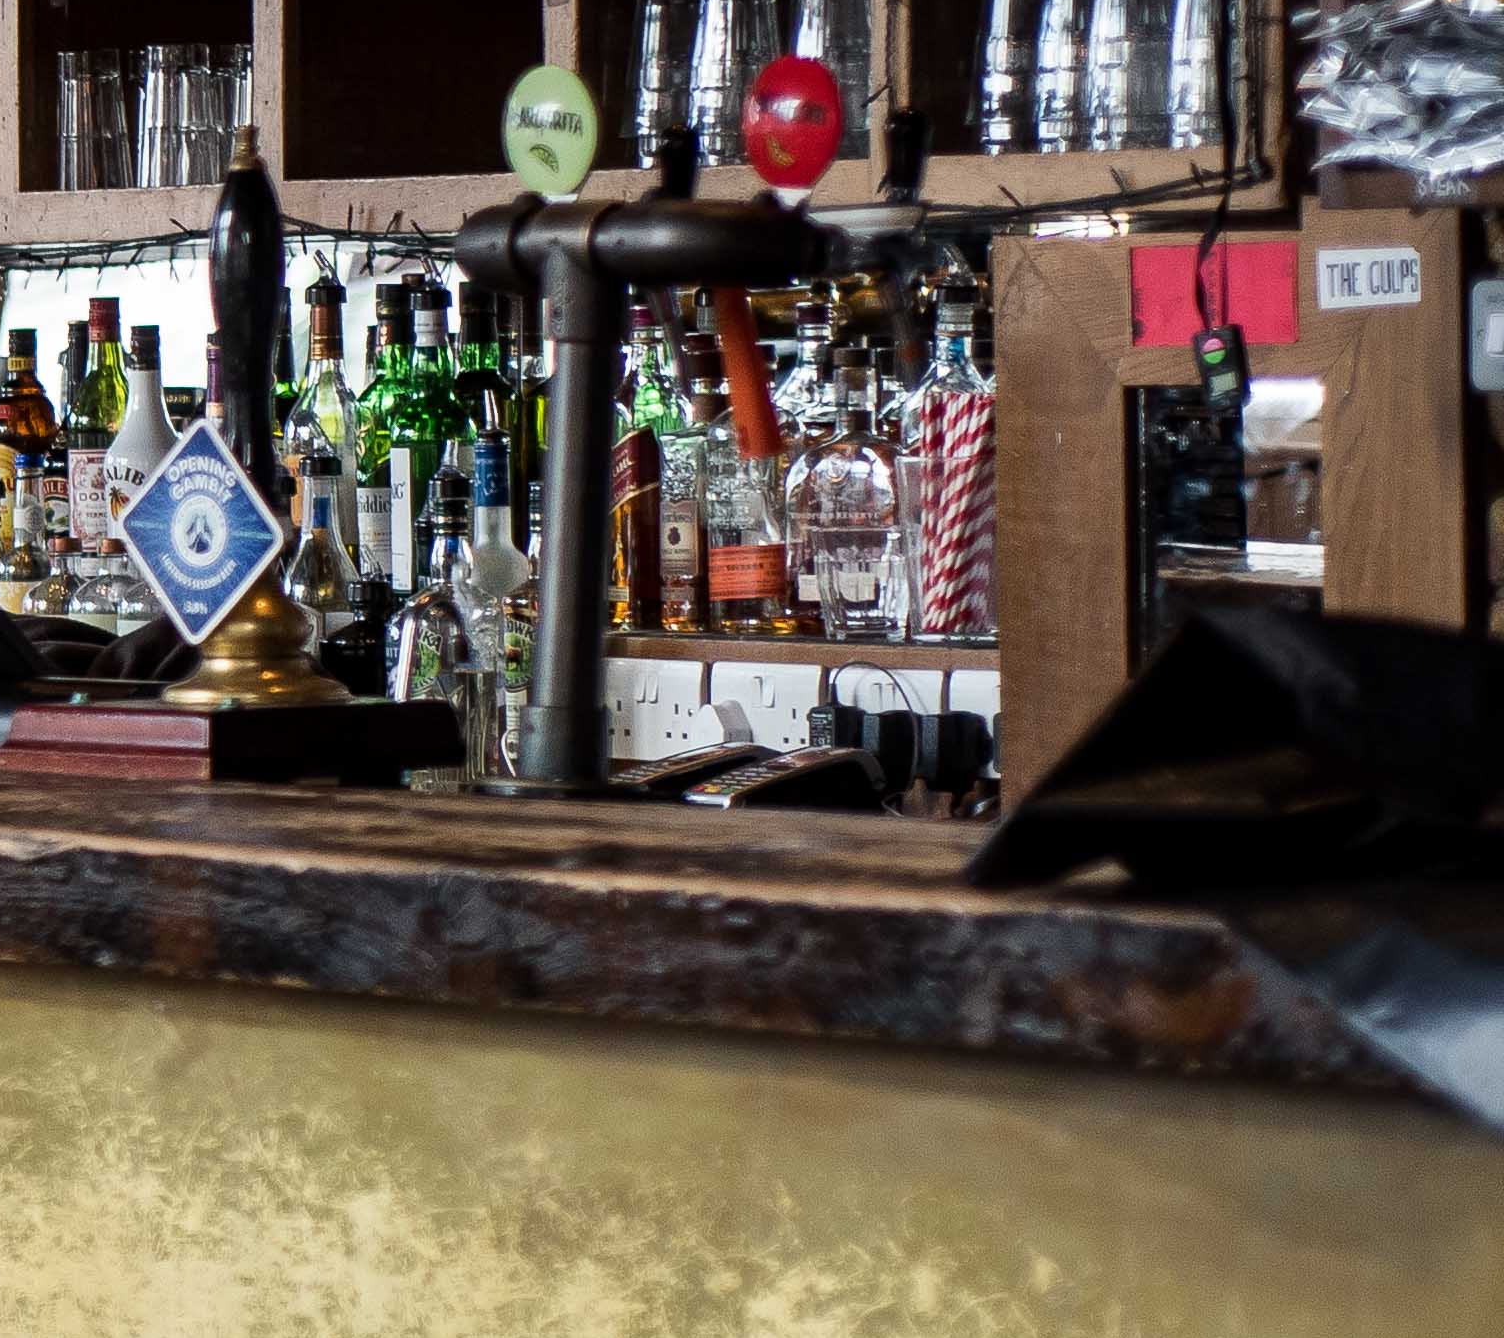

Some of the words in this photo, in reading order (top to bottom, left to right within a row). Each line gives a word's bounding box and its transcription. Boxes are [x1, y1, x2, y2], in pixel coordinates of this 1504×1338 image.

[1326, 262, 1362, 298] THE
[1369, 258, 1419, 295] GULPS
[165, 455, 238, 488] OPENING
[170, 474, 234, 504] GAMBIT
